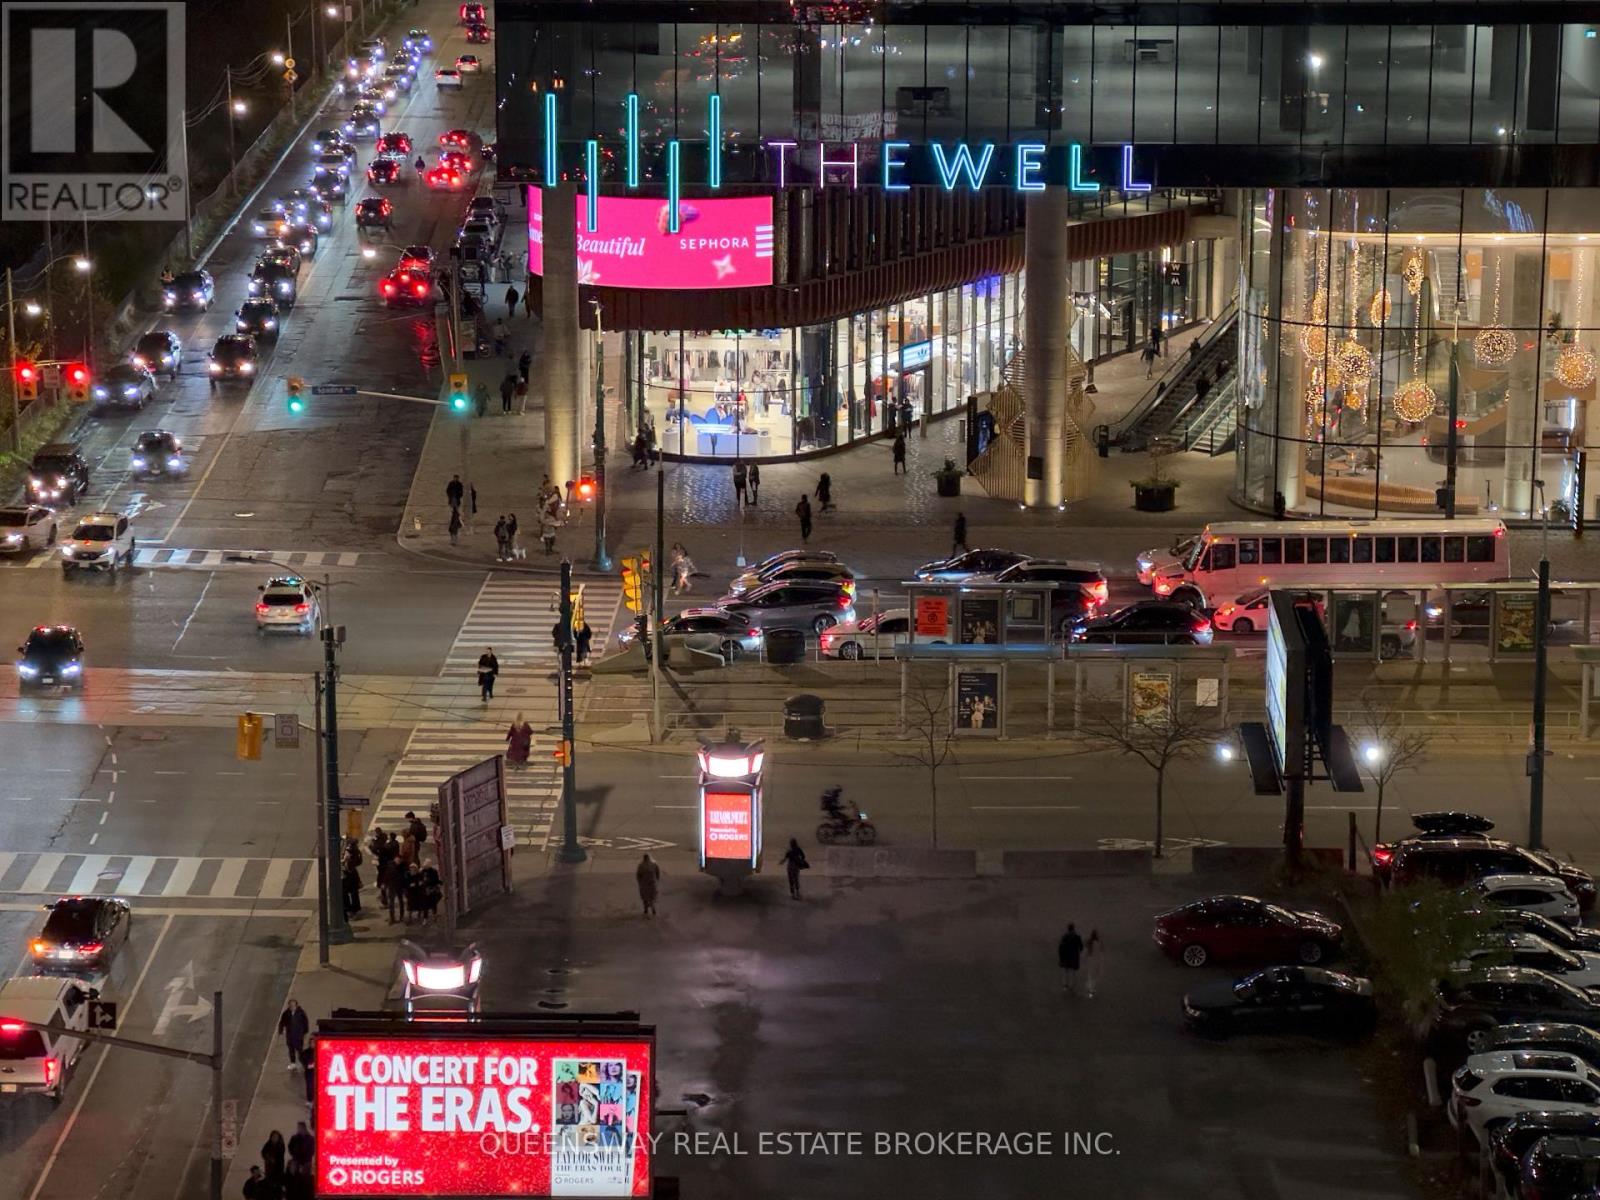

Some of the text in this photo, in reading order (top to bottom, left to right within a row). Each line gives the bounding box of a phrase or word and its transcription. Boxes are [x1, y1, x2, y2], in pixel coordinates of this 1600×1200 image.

[680, 238, 749, 250] SEPHORA
[328, 1055, 539, 1086] A CONCERT FOR
[327, 1086, 540, 1134] THE ERAS.
[329, 1156, 398, 1168] Presented by
[556, 1151, 591, 1165] TAYLOR
[351, 1170, 425, 1186] ROGERS
